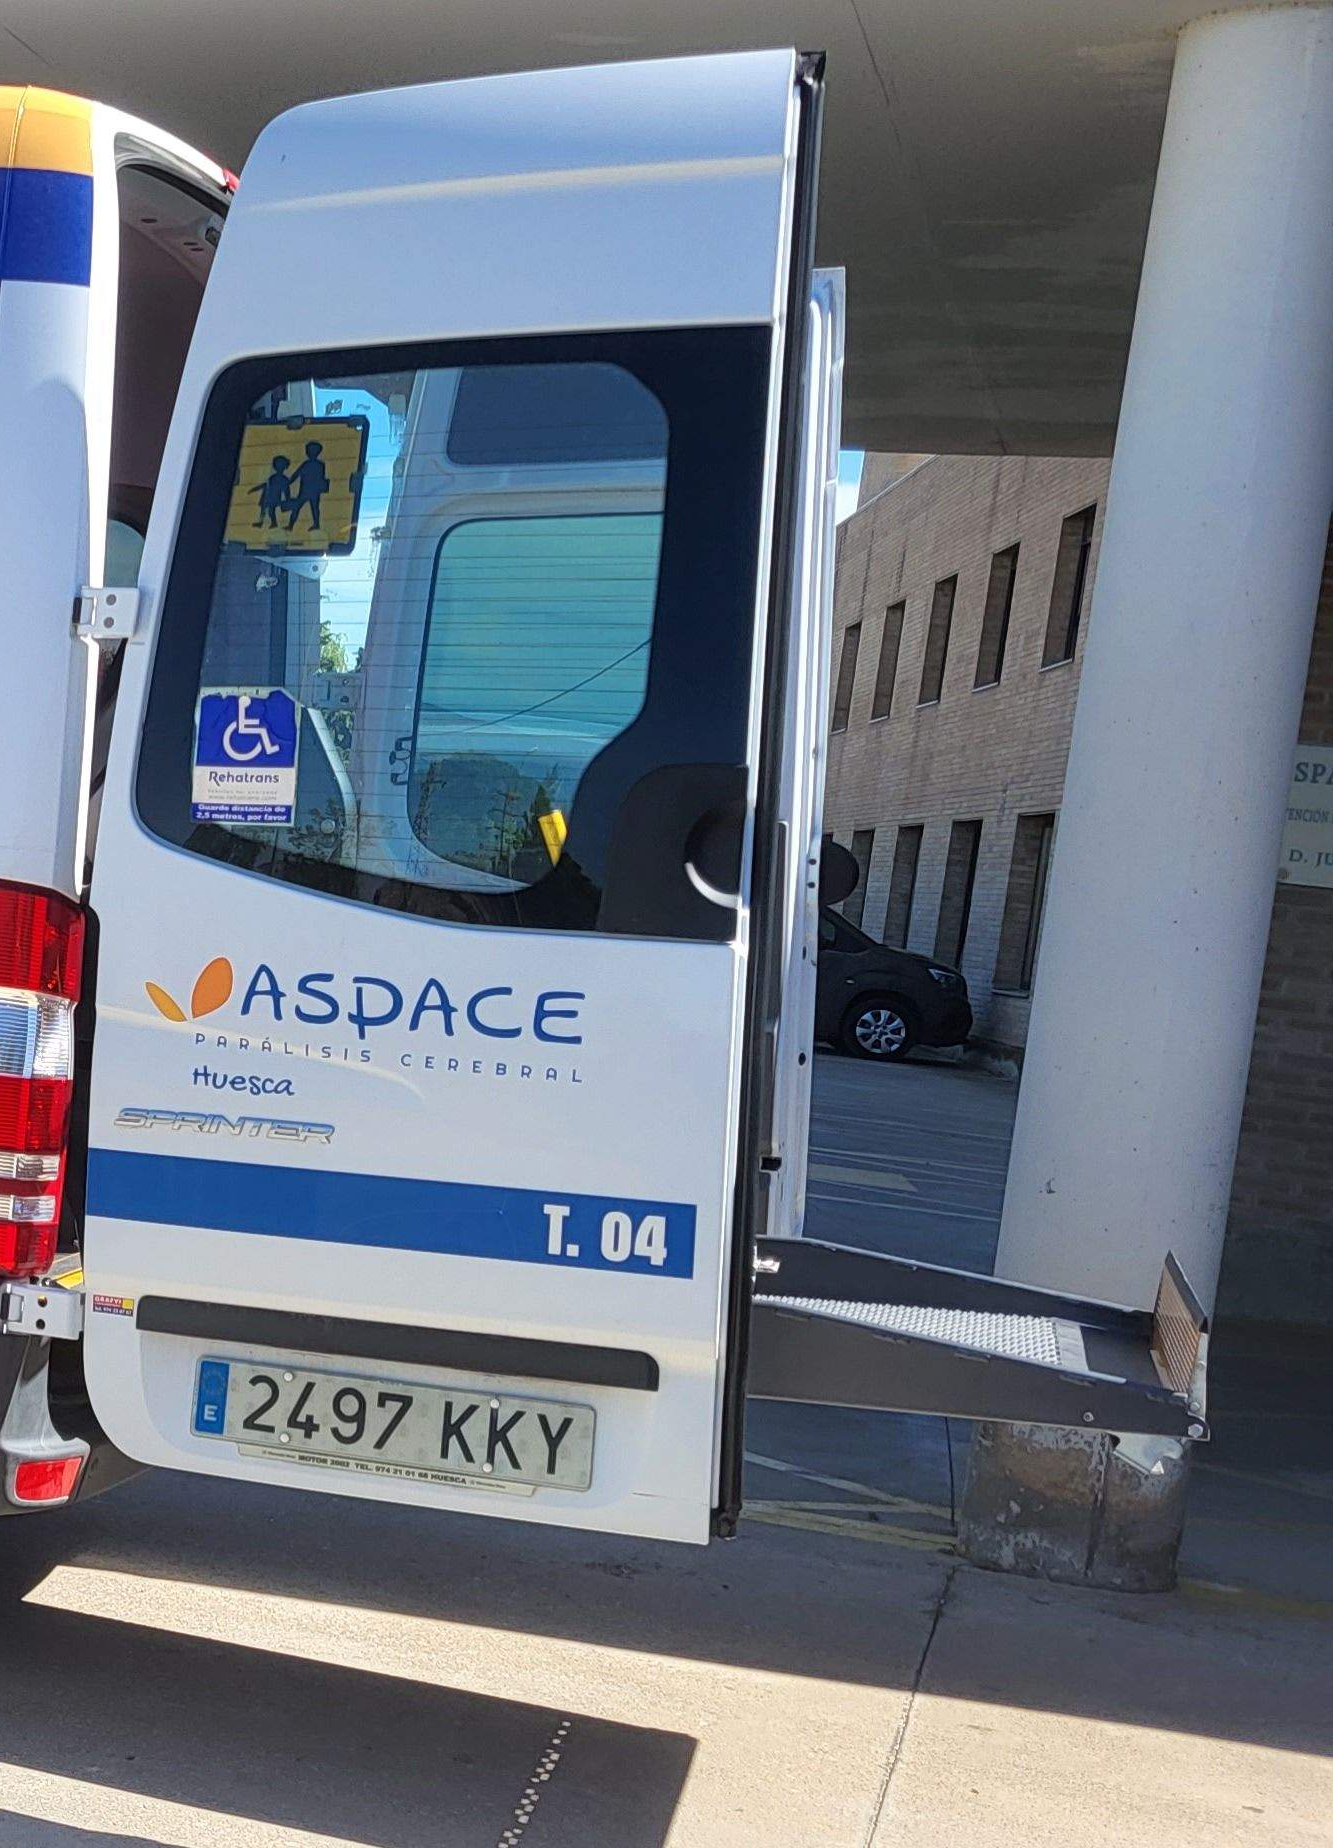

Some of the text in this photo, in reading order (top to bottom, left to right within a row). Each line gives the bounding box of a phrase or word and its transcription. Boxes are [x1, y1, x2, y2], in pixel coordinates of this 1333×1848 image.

[209, 771, 280, 787] Rehatrans
[231, 804, 272, 813] distancia
[274, 805, 286, 813] de
[264, 813, 287, 822] favor
[241, 964, 586, 1046] ASPACE
[194, 1032, 584, 1084] PARÁLISIS CEREBRAL
[192, 1065, 296, 1098] Huesca
[113, 1106, 336, 1146] SPRINTER
[542, 1203, 669, 1267] T. 04
[203, 1403, 218, 1422] E
[242, 1374, 575, 1476] 2497 KKY
[375, 1464, 391, 1474] 974
[431, 1473, 467, 1485] HUESCA
